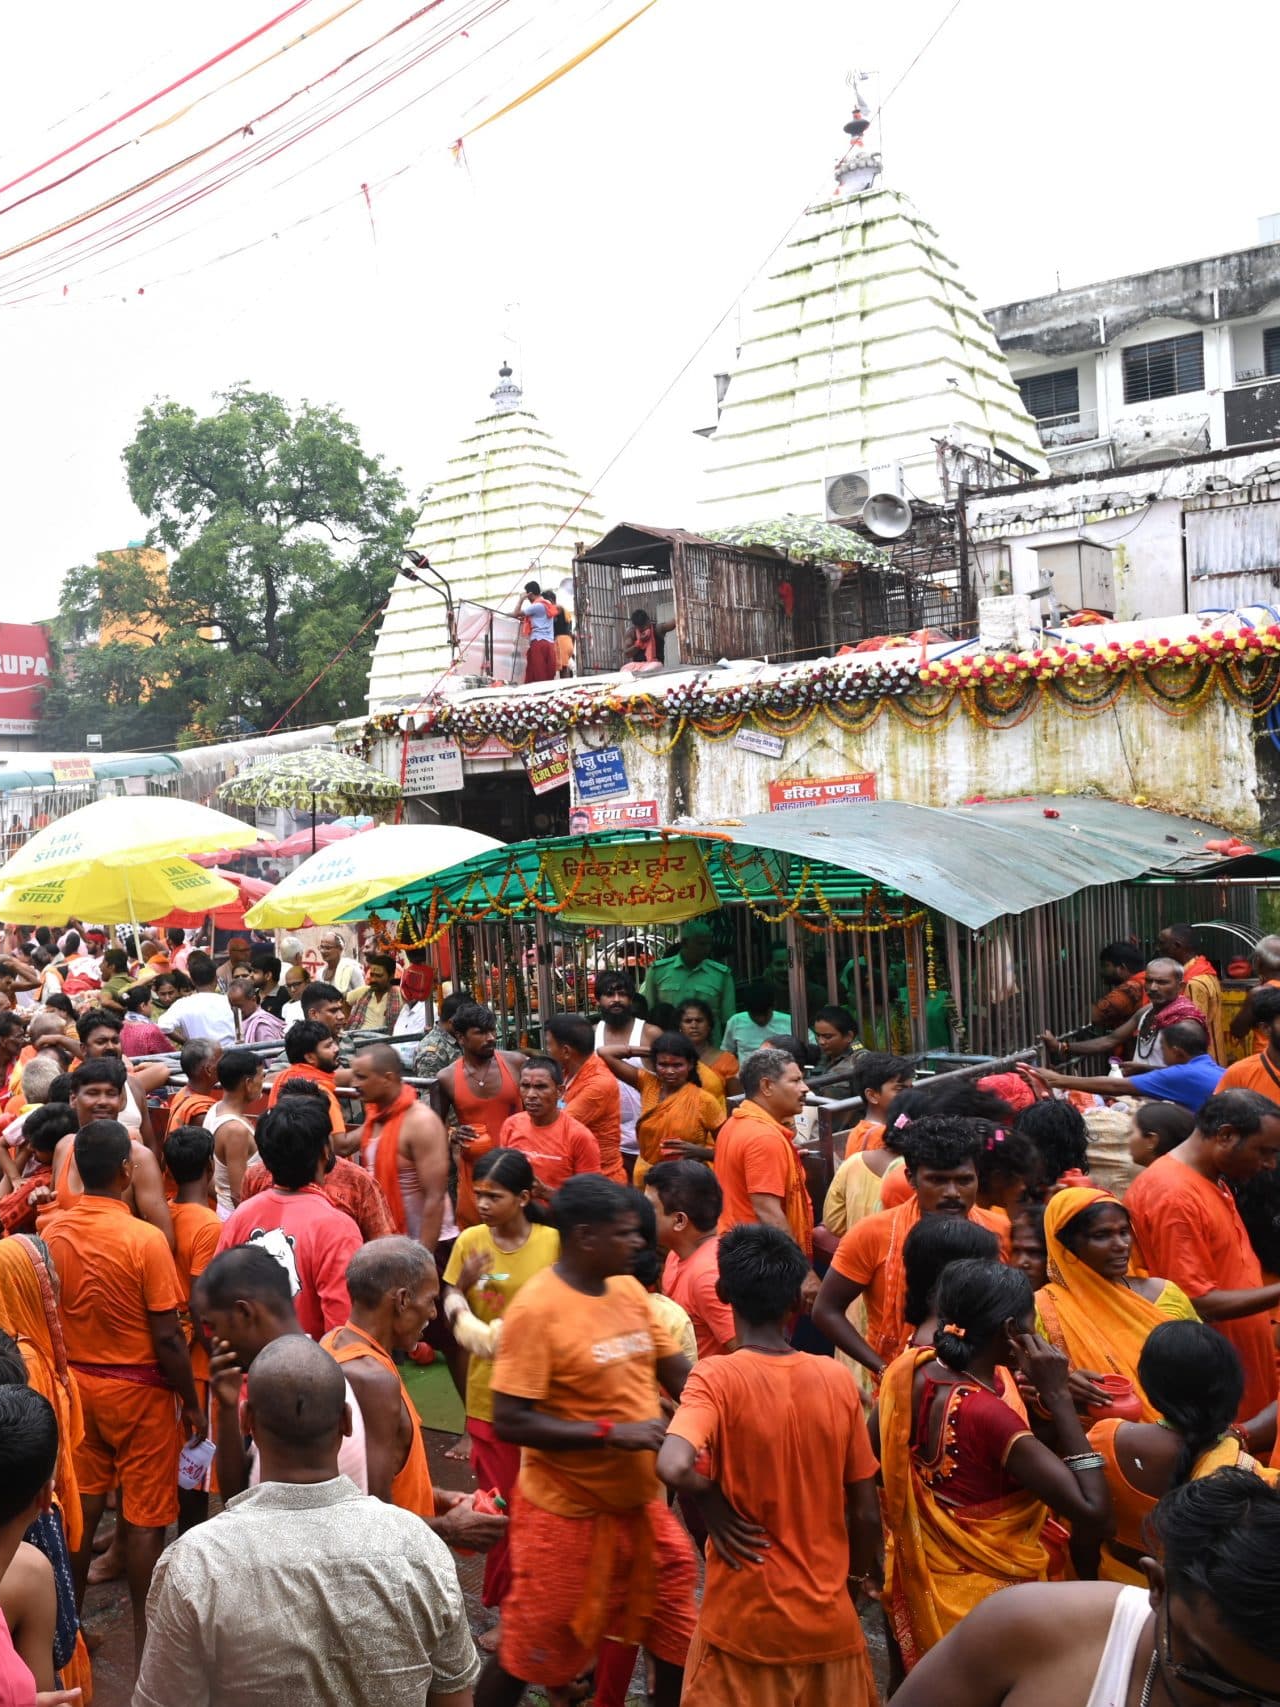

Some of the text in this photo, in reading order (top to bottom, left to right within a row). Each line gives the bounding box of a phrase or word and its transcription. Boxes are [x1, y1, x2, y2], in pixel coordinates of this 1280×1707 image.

[596, 749, 619, 763] पंडा
[782, 783, 863, 800] हरिहर पण्डा
[625, 803, 653, 818] पंडा
[645, 855, 687, 878] द्वार
[37, 879, 65, 889] ALL
[171, 876, 211, 891] STEELS
[19, 892, 65, 904] STEELS
